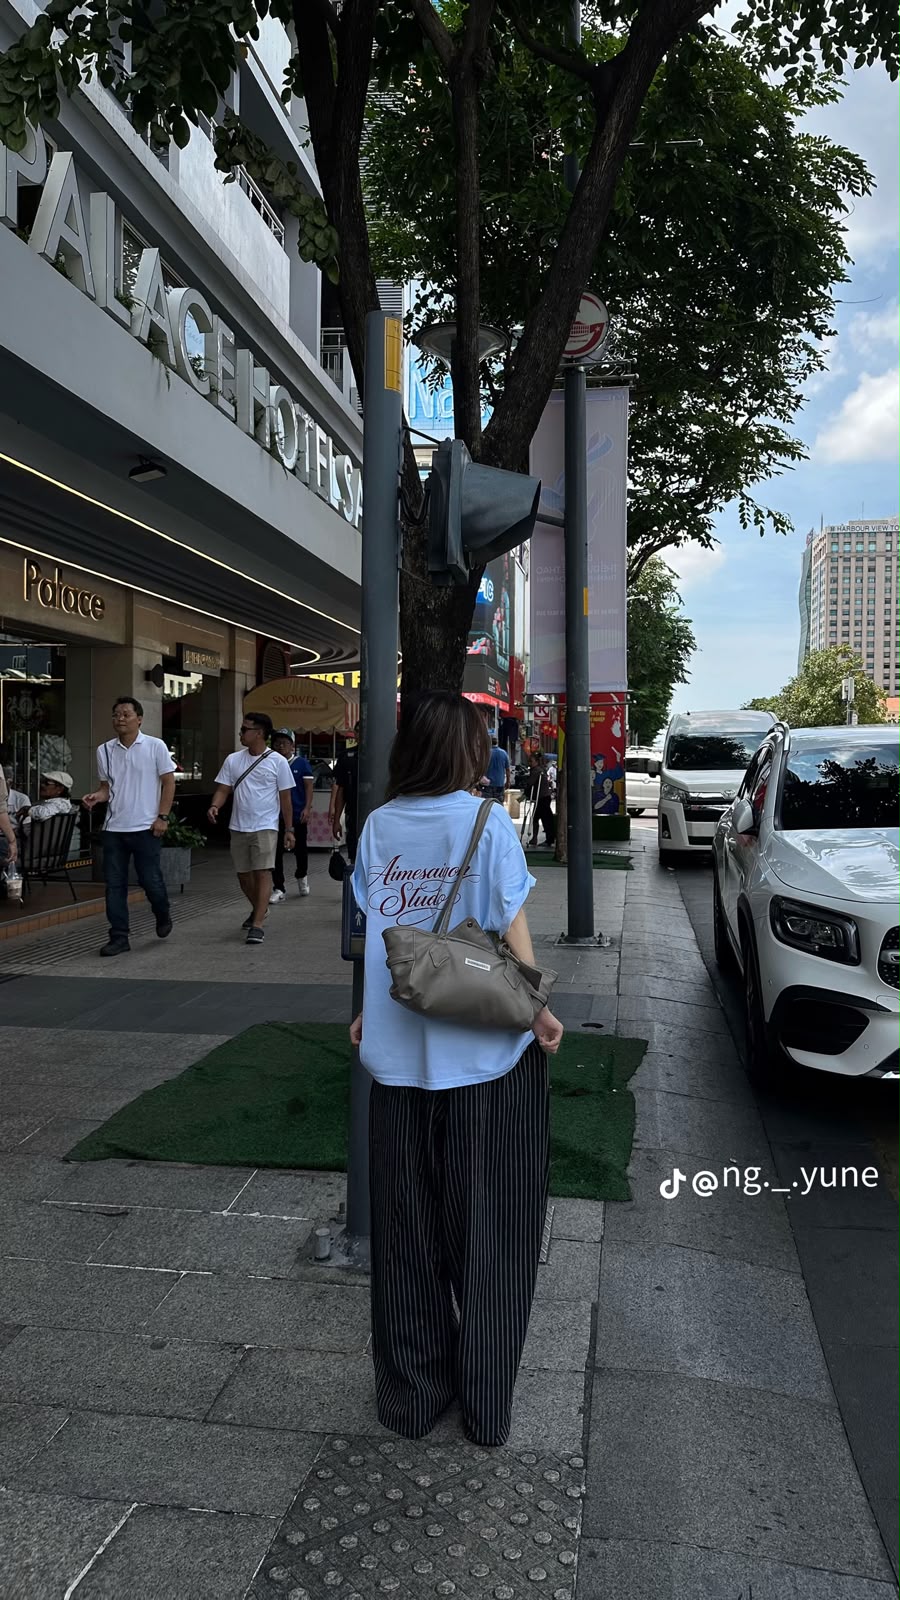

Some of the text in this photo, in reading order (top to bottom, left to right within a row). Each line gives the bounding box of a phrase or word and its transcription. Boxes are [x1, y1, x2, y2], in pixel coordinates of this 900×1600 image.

[0, 115, 237, 423] PALACE
[237, 348, 339, 510] HOTEL
[23, 557, 106, 622] Palace
